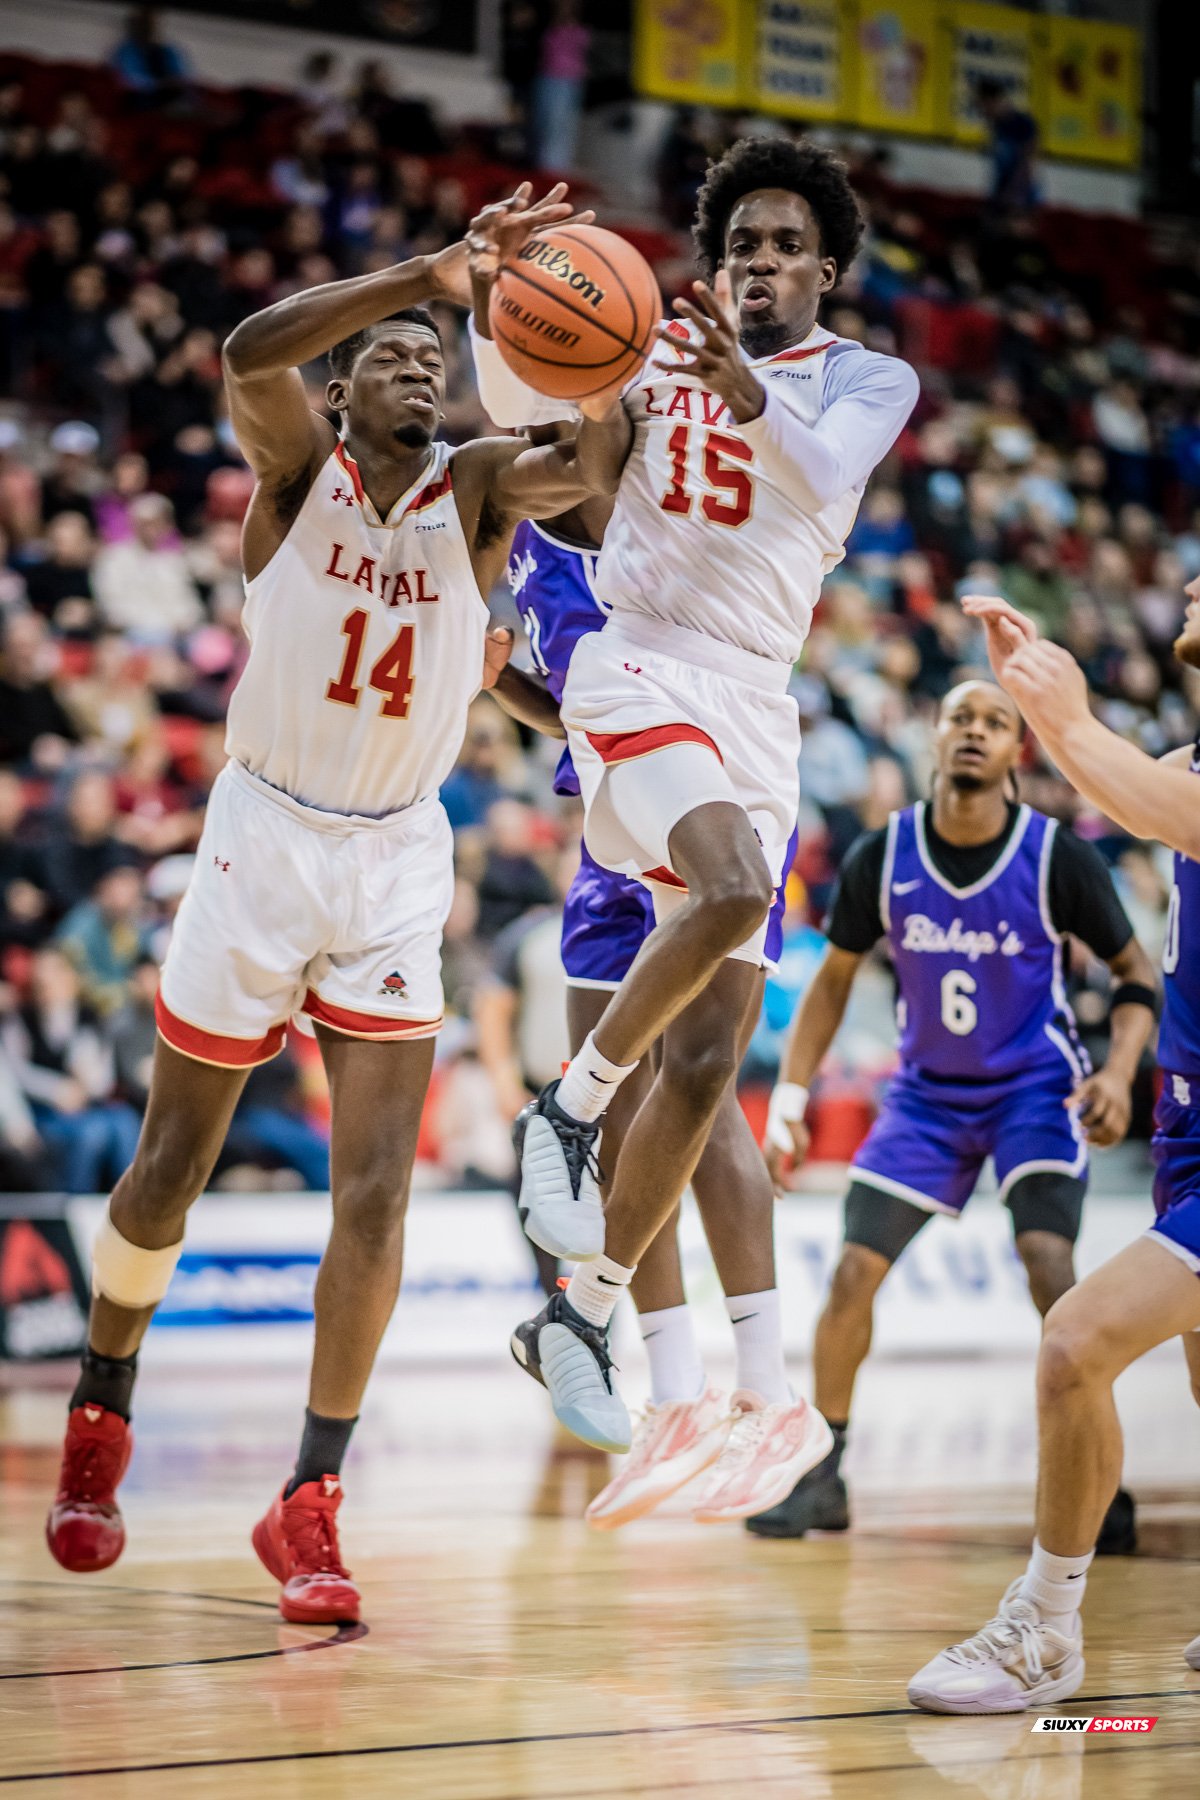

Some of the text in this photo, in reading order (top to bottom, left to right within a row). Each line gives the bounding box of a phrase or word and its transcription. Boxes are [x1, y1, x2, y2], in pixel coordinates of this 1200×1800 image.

[517, 240, 606, 310] Wilson
[499, 293, 581, 347] VOLUTION
[786, 372, 812, 380] TELUS
[642, 385, 733, 429] LAV
[660, 422, 755, 531] 15
[422, 522, 446, 531] TELUS
[324, 606, 416, 720] 14
[901, 914, 1025, 963] Bishop's
[941, 969, 977, 1036] 6
